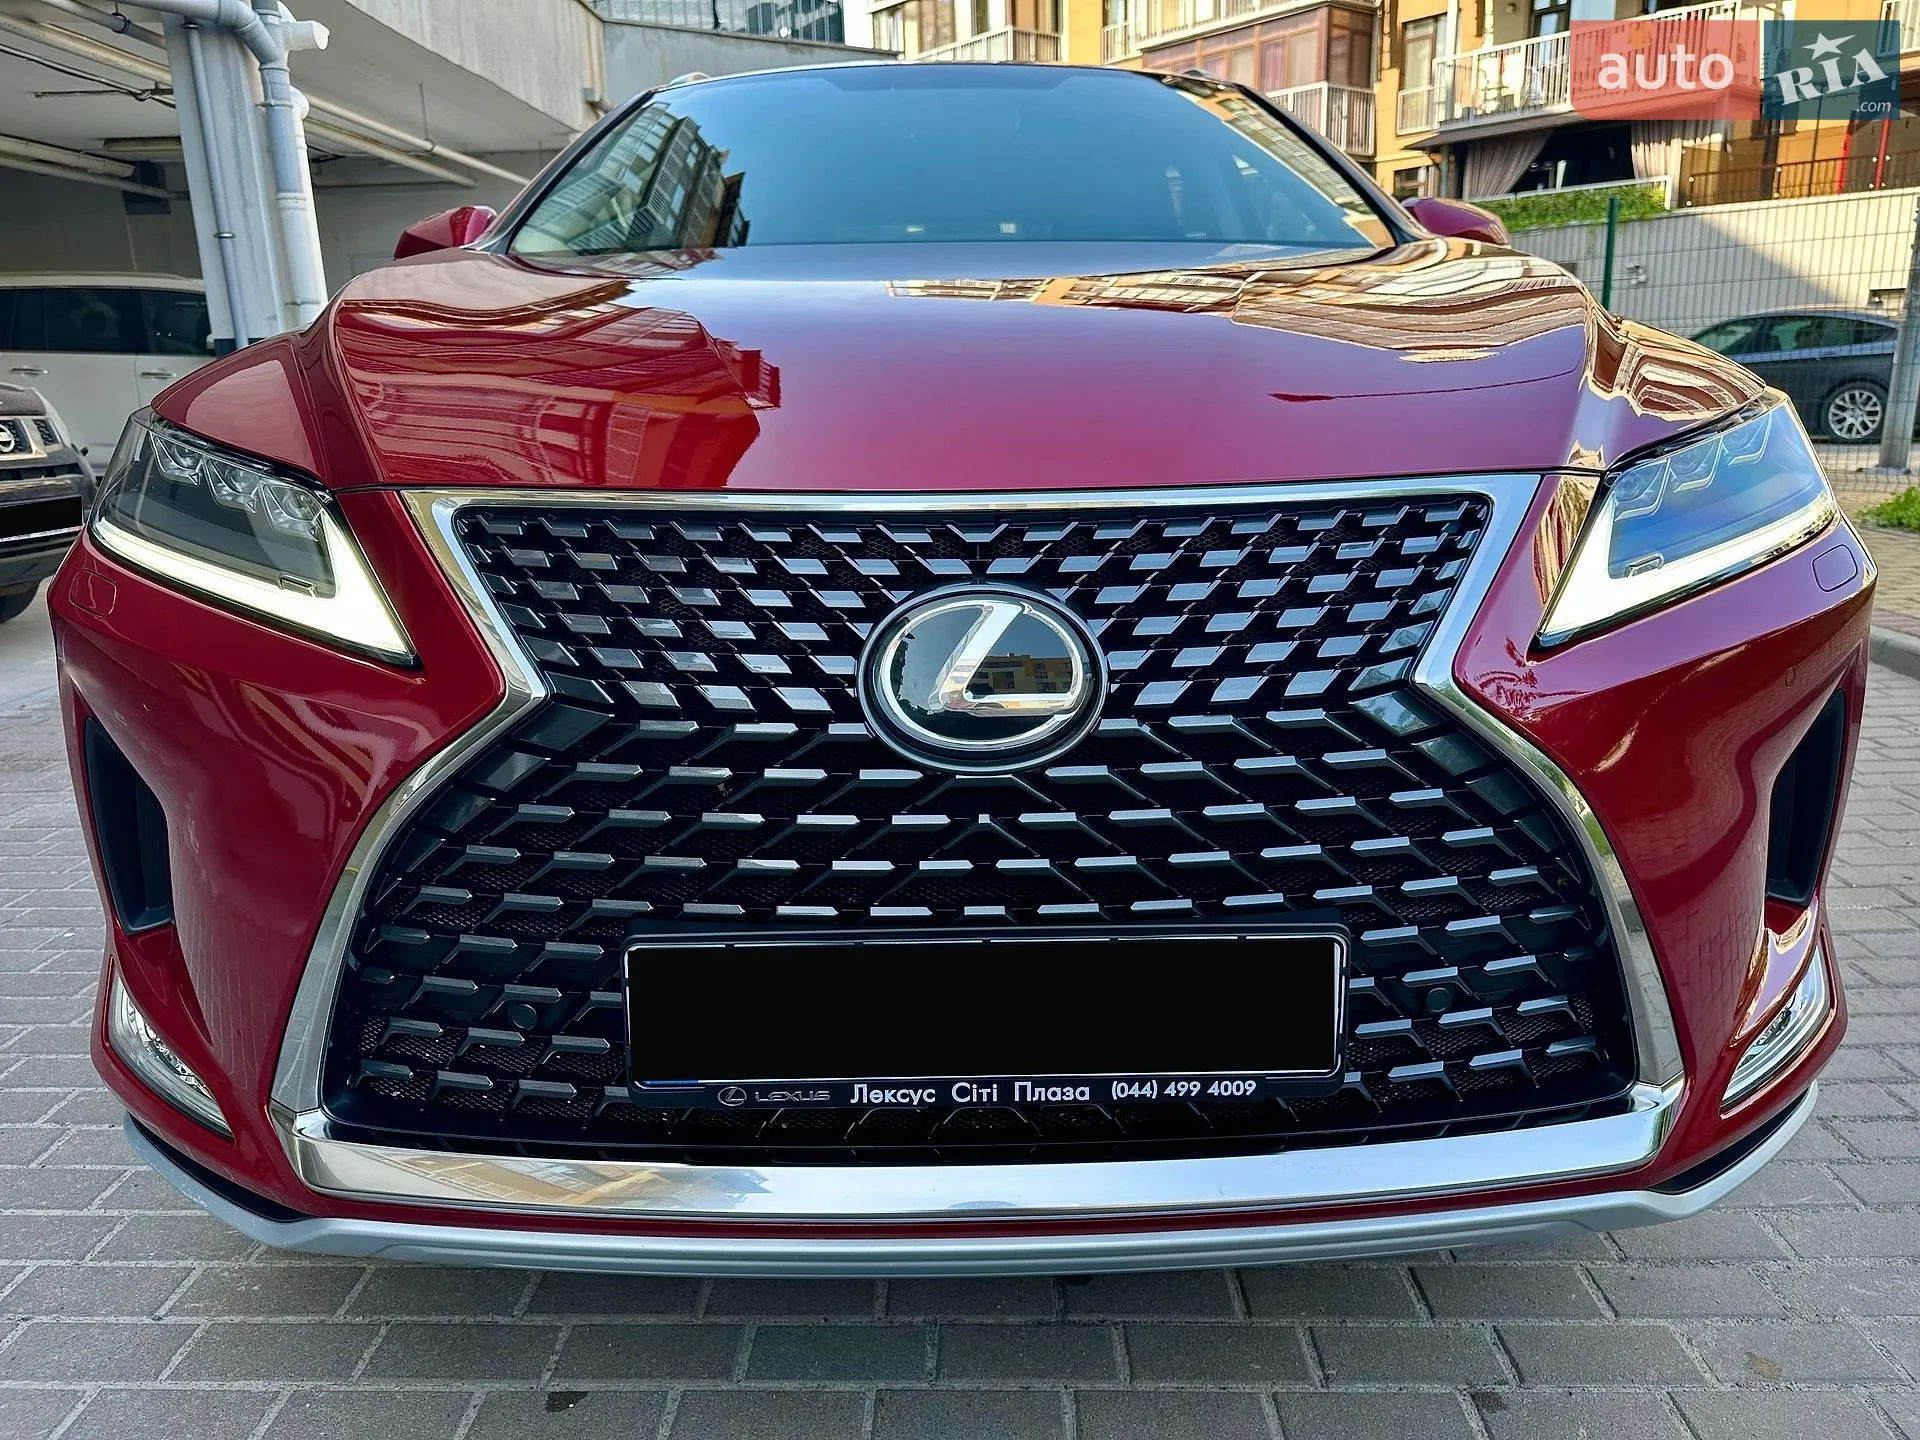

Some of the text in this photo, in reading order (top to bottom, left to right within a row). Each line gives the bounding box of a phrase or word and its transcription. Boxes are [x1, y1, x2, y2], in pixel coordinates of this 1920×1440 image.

[755, 1090, 831, 1102] LEXUS
[850, 1080, 1257, 1105] Лексус Сіті Плаза (044) 499 4009
